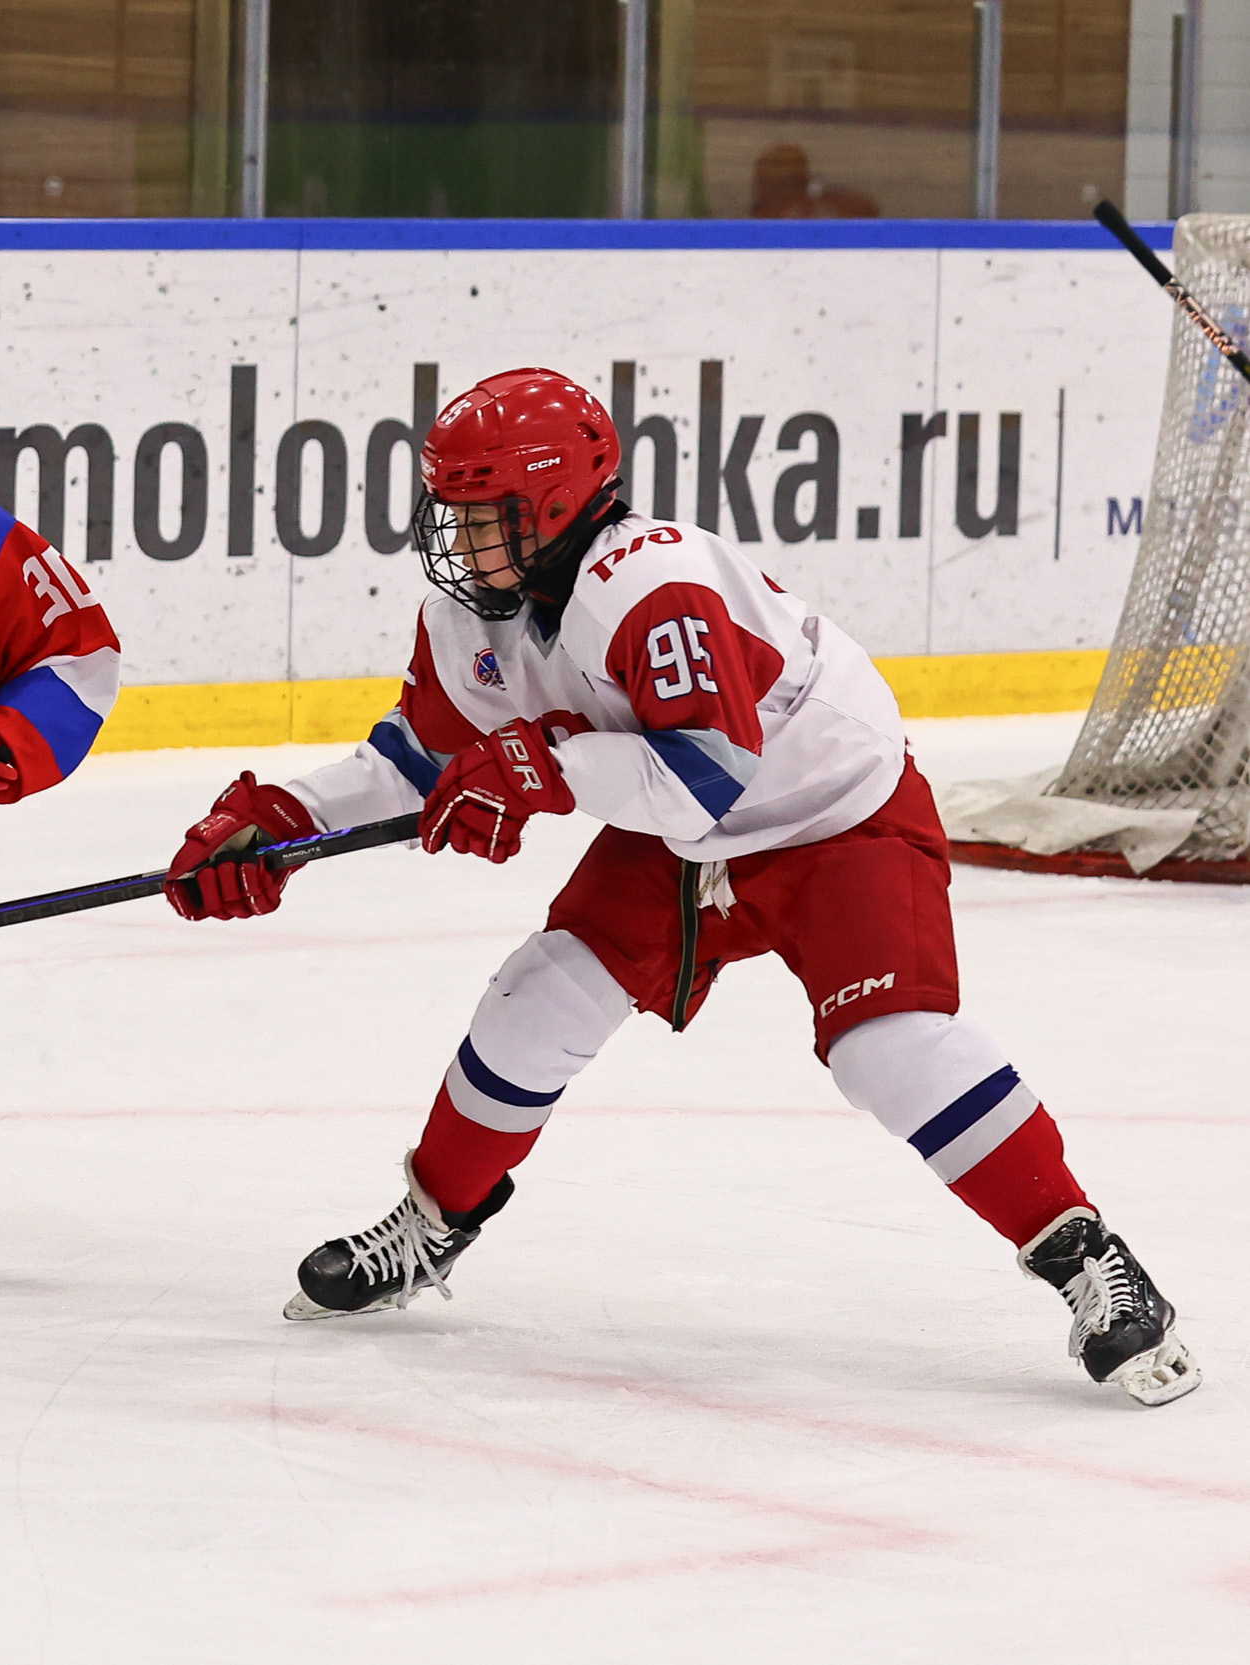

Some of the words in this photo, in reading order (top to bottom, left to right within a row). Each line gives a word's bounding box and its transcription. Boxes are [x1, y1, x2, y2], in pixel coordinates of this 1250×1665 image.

[526, 456, 561, 471] CCM
[646, 615, 719, 700] 95
[820, 972, 896, 1019] CCM
